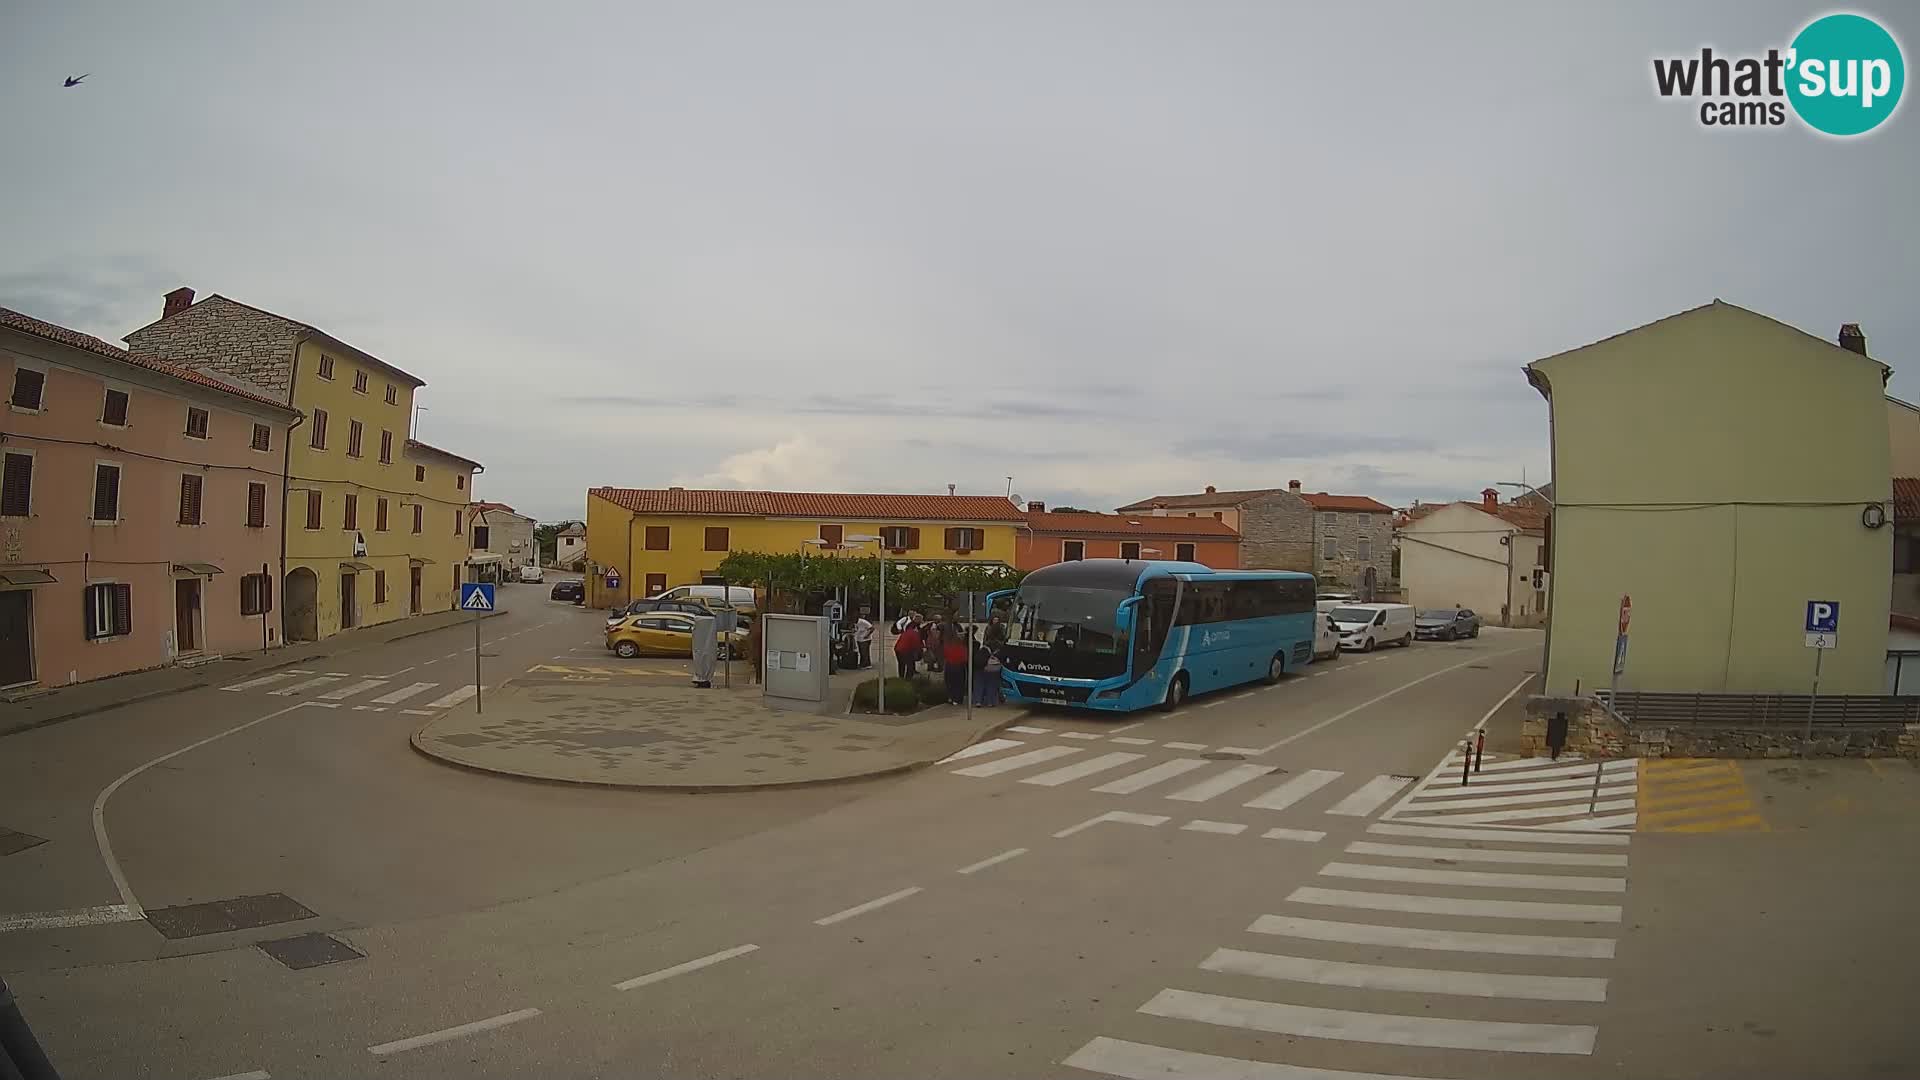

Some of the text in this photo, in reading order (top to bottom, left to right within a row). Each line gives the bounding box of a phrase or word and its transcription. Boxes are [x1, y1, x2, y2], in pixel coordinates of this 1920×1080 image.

[1813, 603, 1832, 626] P
[1027, 663, 1051, 671] arriva
[1040, 687, 1065, 695] MAN
